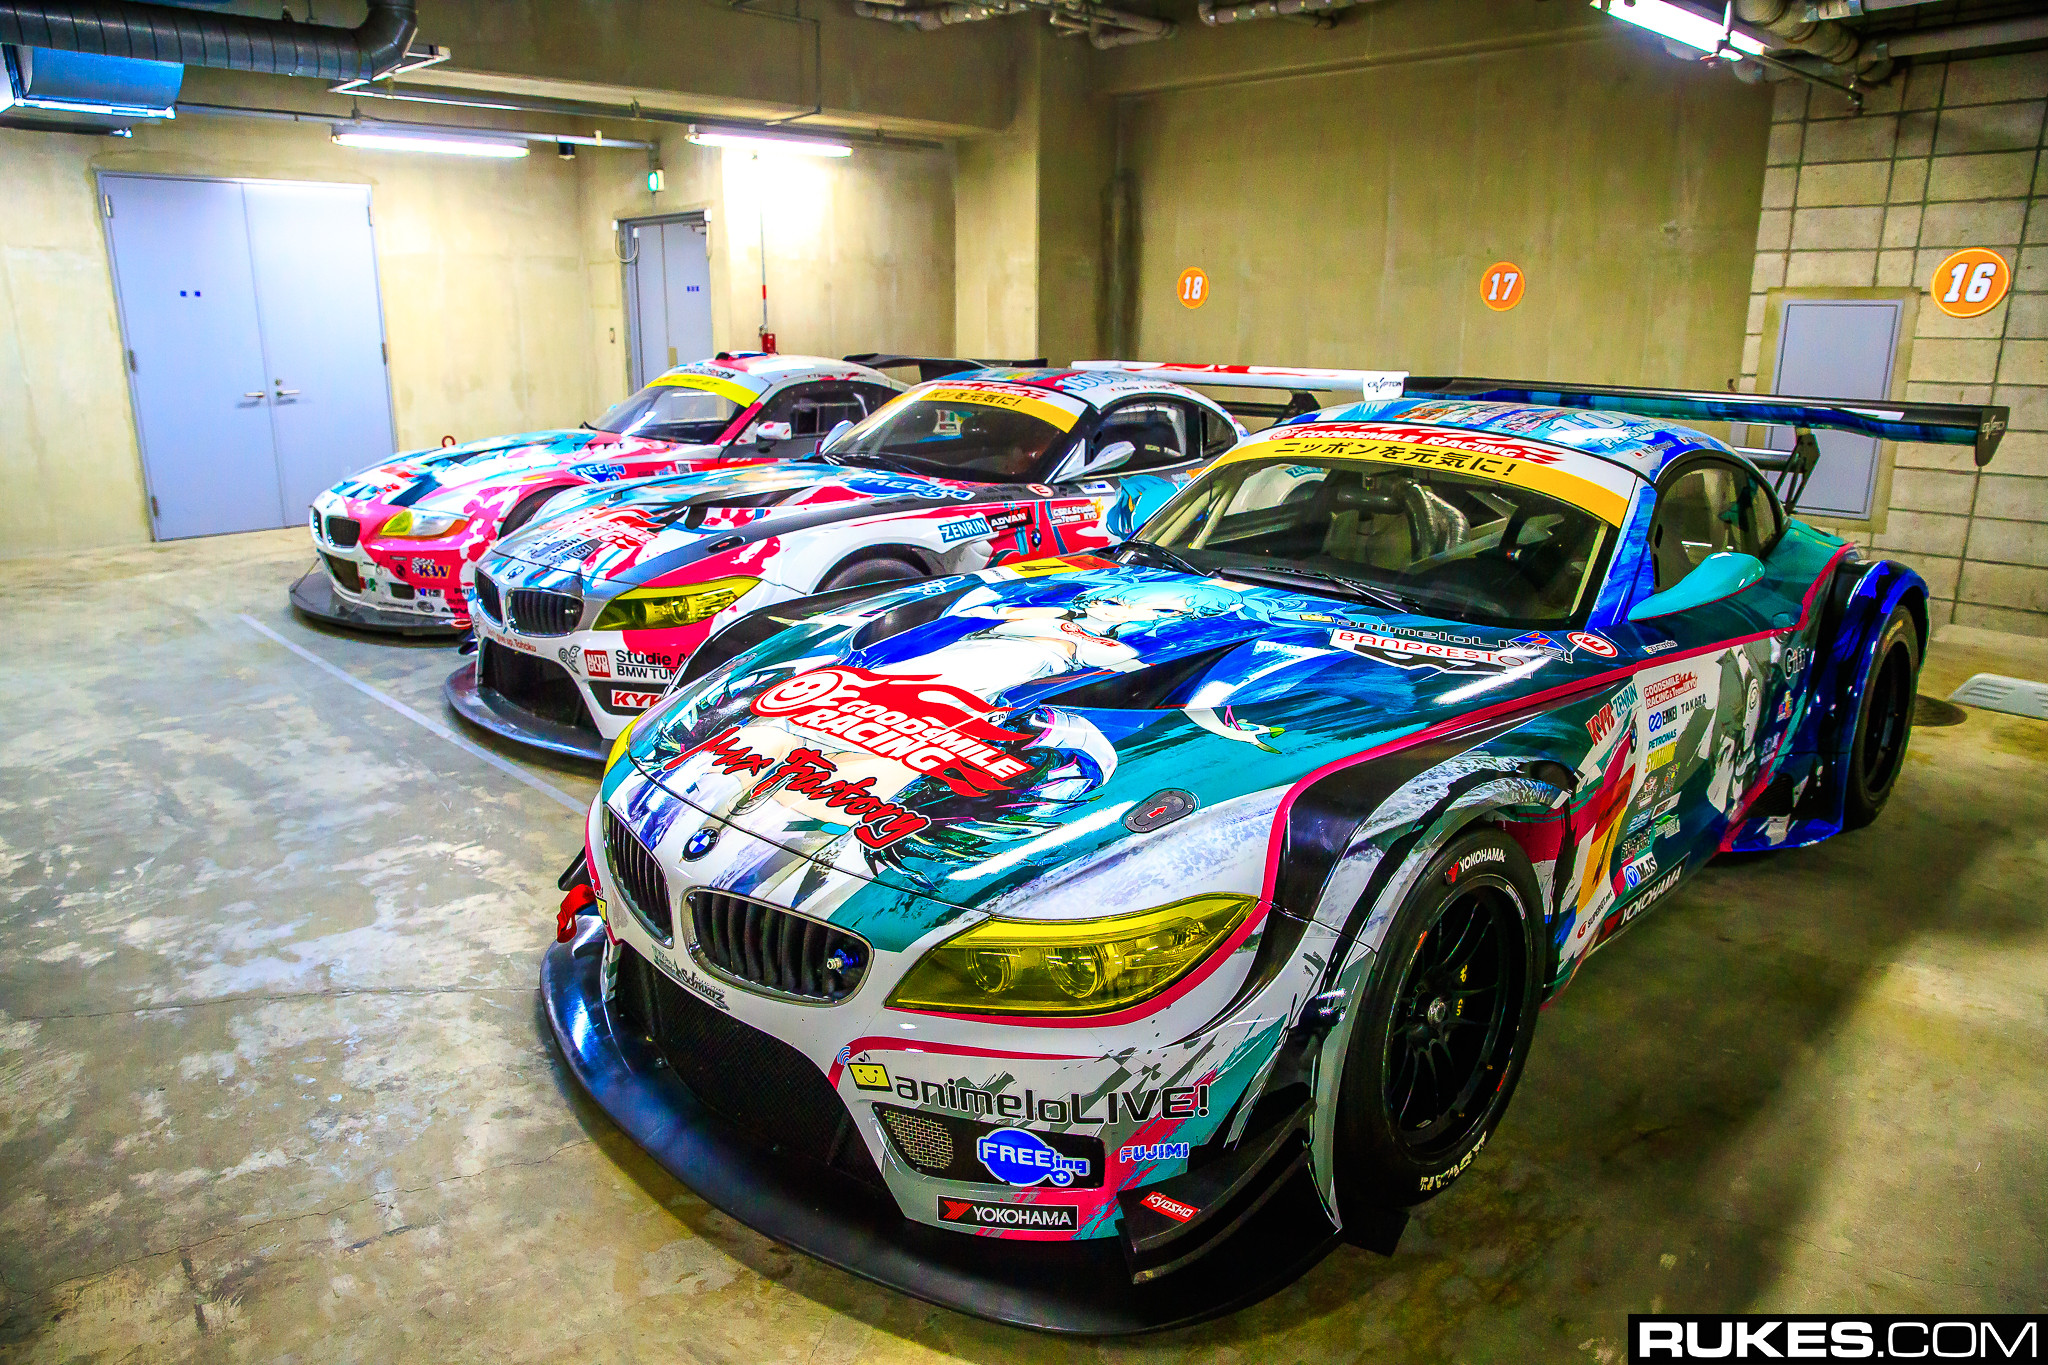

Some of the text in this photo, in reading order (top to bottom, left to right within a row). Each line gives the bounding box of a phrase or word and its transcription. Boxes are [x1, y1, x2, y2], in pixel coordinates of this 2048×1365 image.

[1183, 276, 1203, 299] 18
[1488, 272, 1518, 301] 17
[1943, 262, 1997, 303] 16
[1294, 430, 1522, 457] GOODSMILE RACING
[1274, 441, 1517, 477] ニッポンを元気に!
[940, 520, 988, 542] ZENRIN
[991, 512, 1027, 527] ADVAN
[419, 565, 449, 577] KW
[616, 650, 672, 665] Studie
[1339, 632, 1525, 667] BANPRESTO
[617, 665, 648, 679] BMW
[1612, 682, 1639, 718] ZENRIN
[1681, 693, 1707, 715] TAKATA
[836, 698, 1029, 778] GOODSMILE
[1585, 703, 1615, 747] KYB
[796, 707, 957, 772] RACING
[1648, 729, 1677, 751] PETRONAS
[752, 746, 933, 850] Factory
[1459, 847, 1506, 873] YOKOHAMA
[1620, 865, 1682, 926] YOKOHAMA
[895, 1074, 1210, 1125] animeloLIVE!
[981, 1142, 1089, 1175] FREEing
[1119, 1142, 1190, 1164] FUJIMI
[973, 1206, 1073, 1227] YOKOHAMA
[1147, 1193, 1196, 1218] KYOSHO
